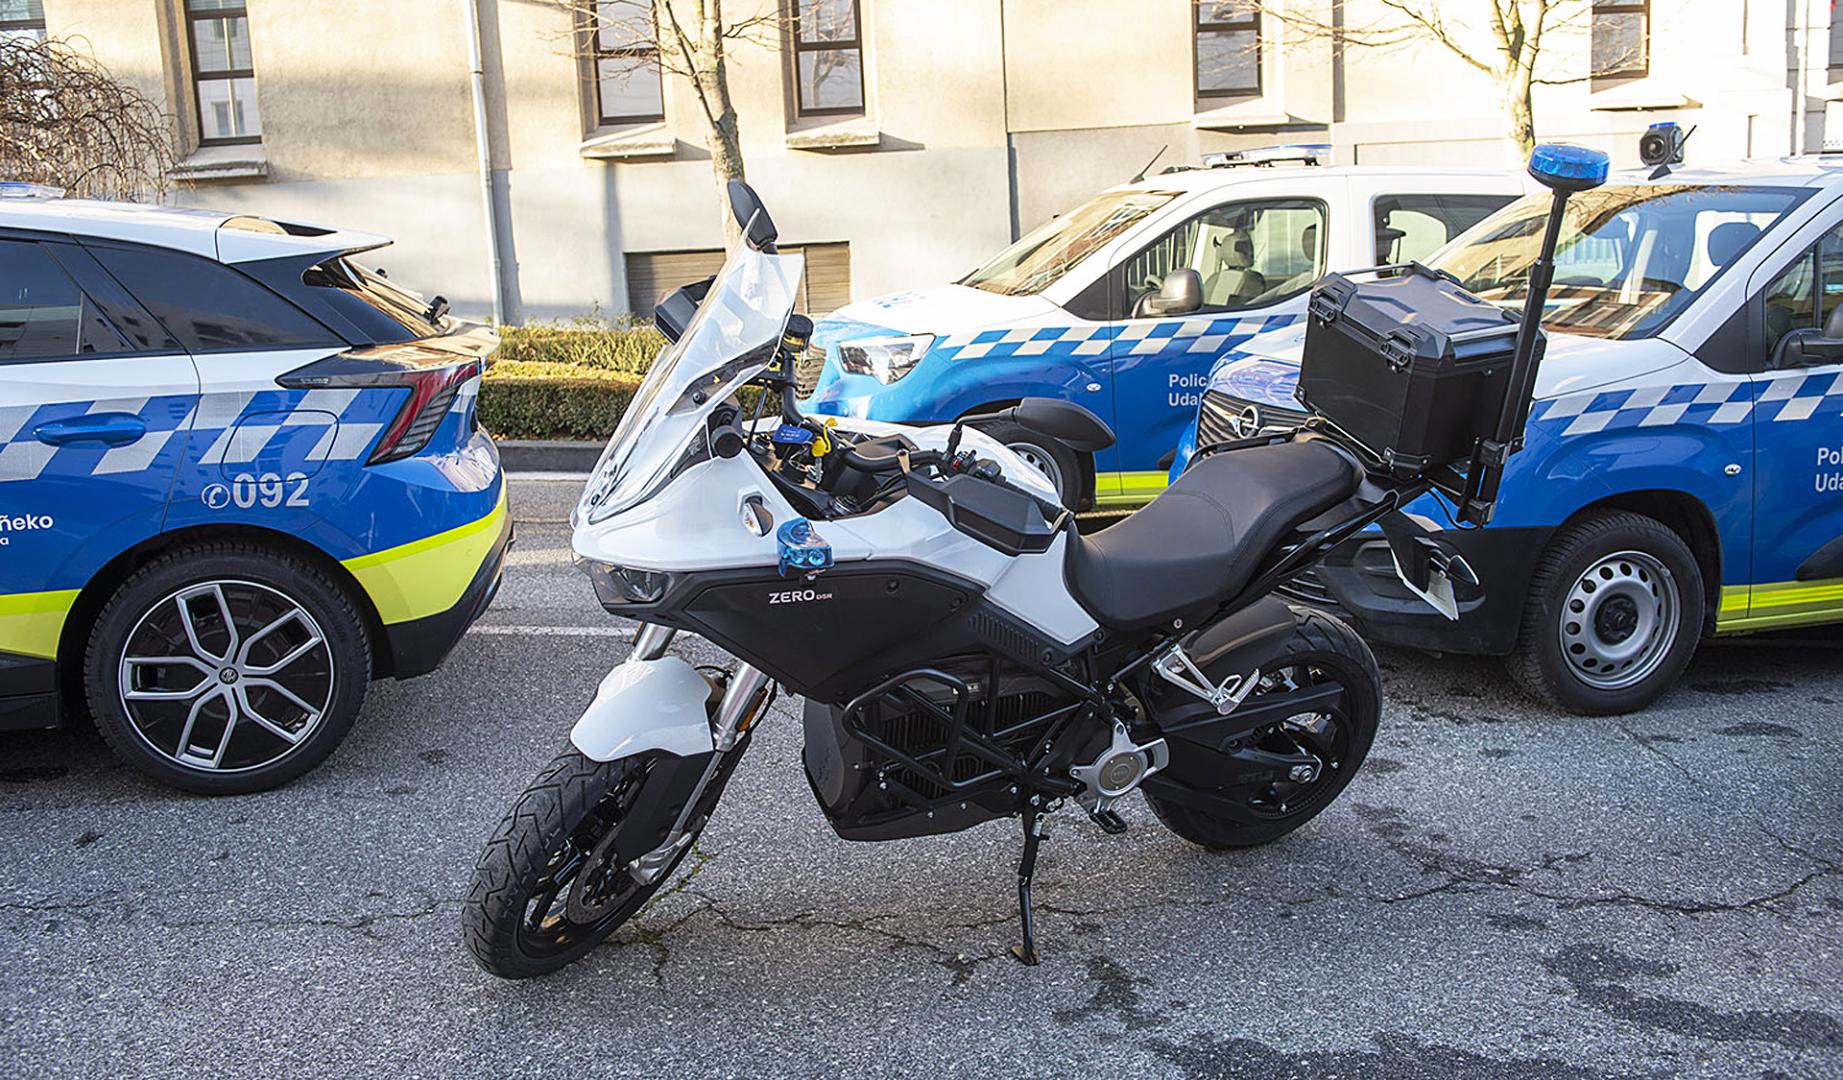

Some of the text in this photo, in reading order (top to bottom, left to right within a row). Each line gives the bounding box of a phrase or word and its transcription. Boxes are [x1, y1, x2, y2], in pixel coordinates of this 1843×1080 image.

[1168, 373, 1208, 388] Polic
[232, 471, 310, 509] 092
[0, 513, 54, 532] ñeko
[768, 588, 816, 605] ZERO
